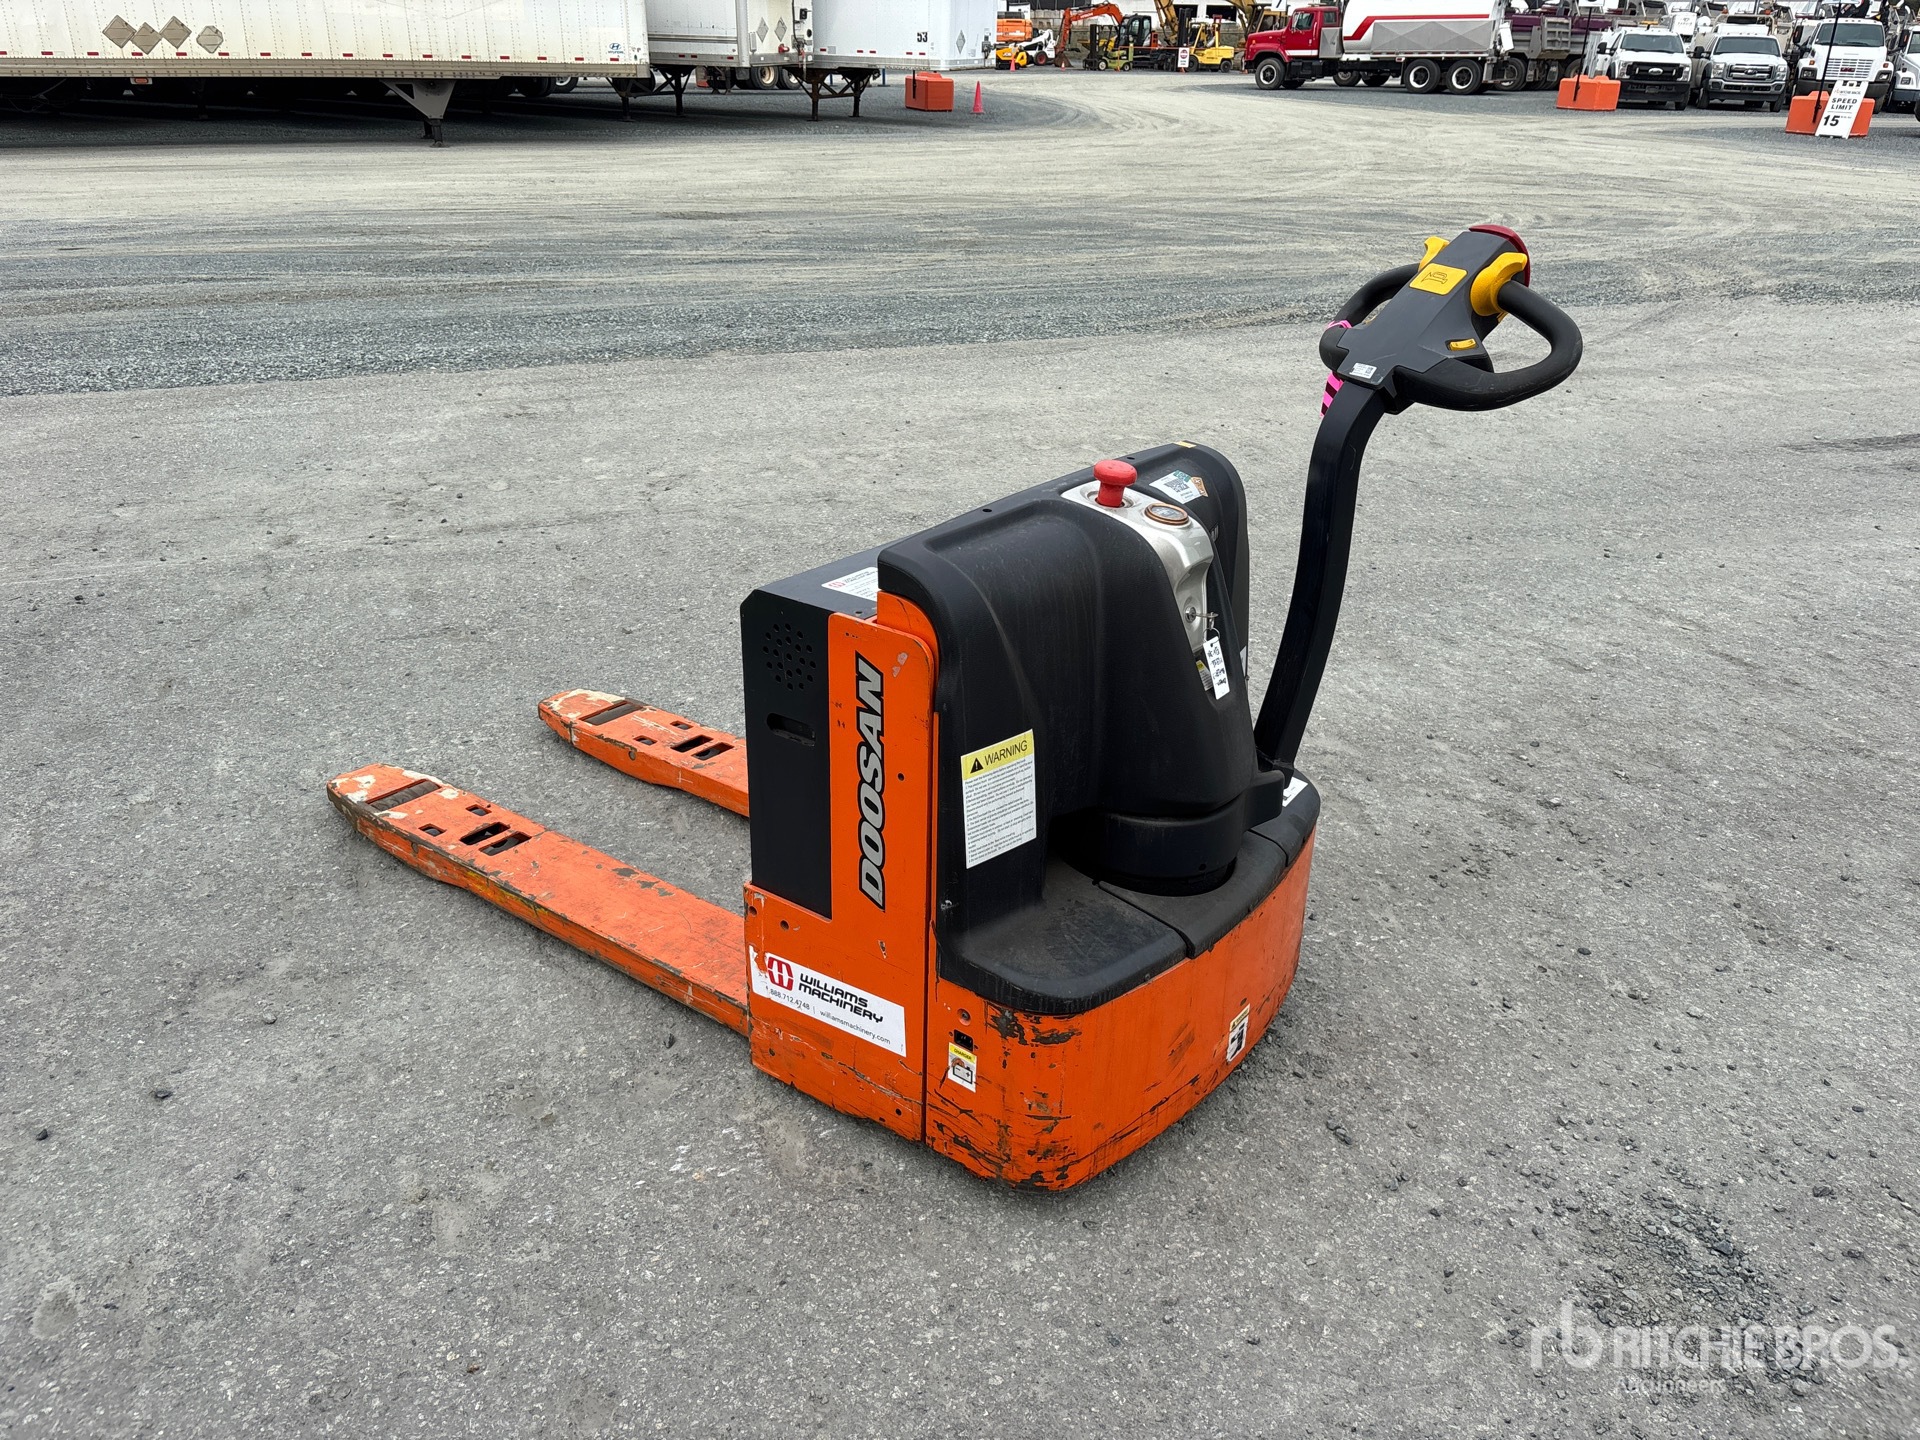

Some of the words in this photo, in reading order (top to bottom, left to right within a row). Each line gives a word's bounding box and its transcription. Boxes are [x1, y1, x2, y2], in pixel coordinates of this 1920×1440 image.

[917, 32, 928, 42] 53
[1824, 115, 1840, 126] 15
[985, 740, 1028, 766] WARNING
[855, 650, 886, 913] DOOSAN
[799, 983, 884, 1023] MACHINERY
[800, 973, 868, 1008] WILLIAMS
[820, 1010, 891, 1044] williamsmachinery.com
[953, 1048, 972, 1060] CHARGER
